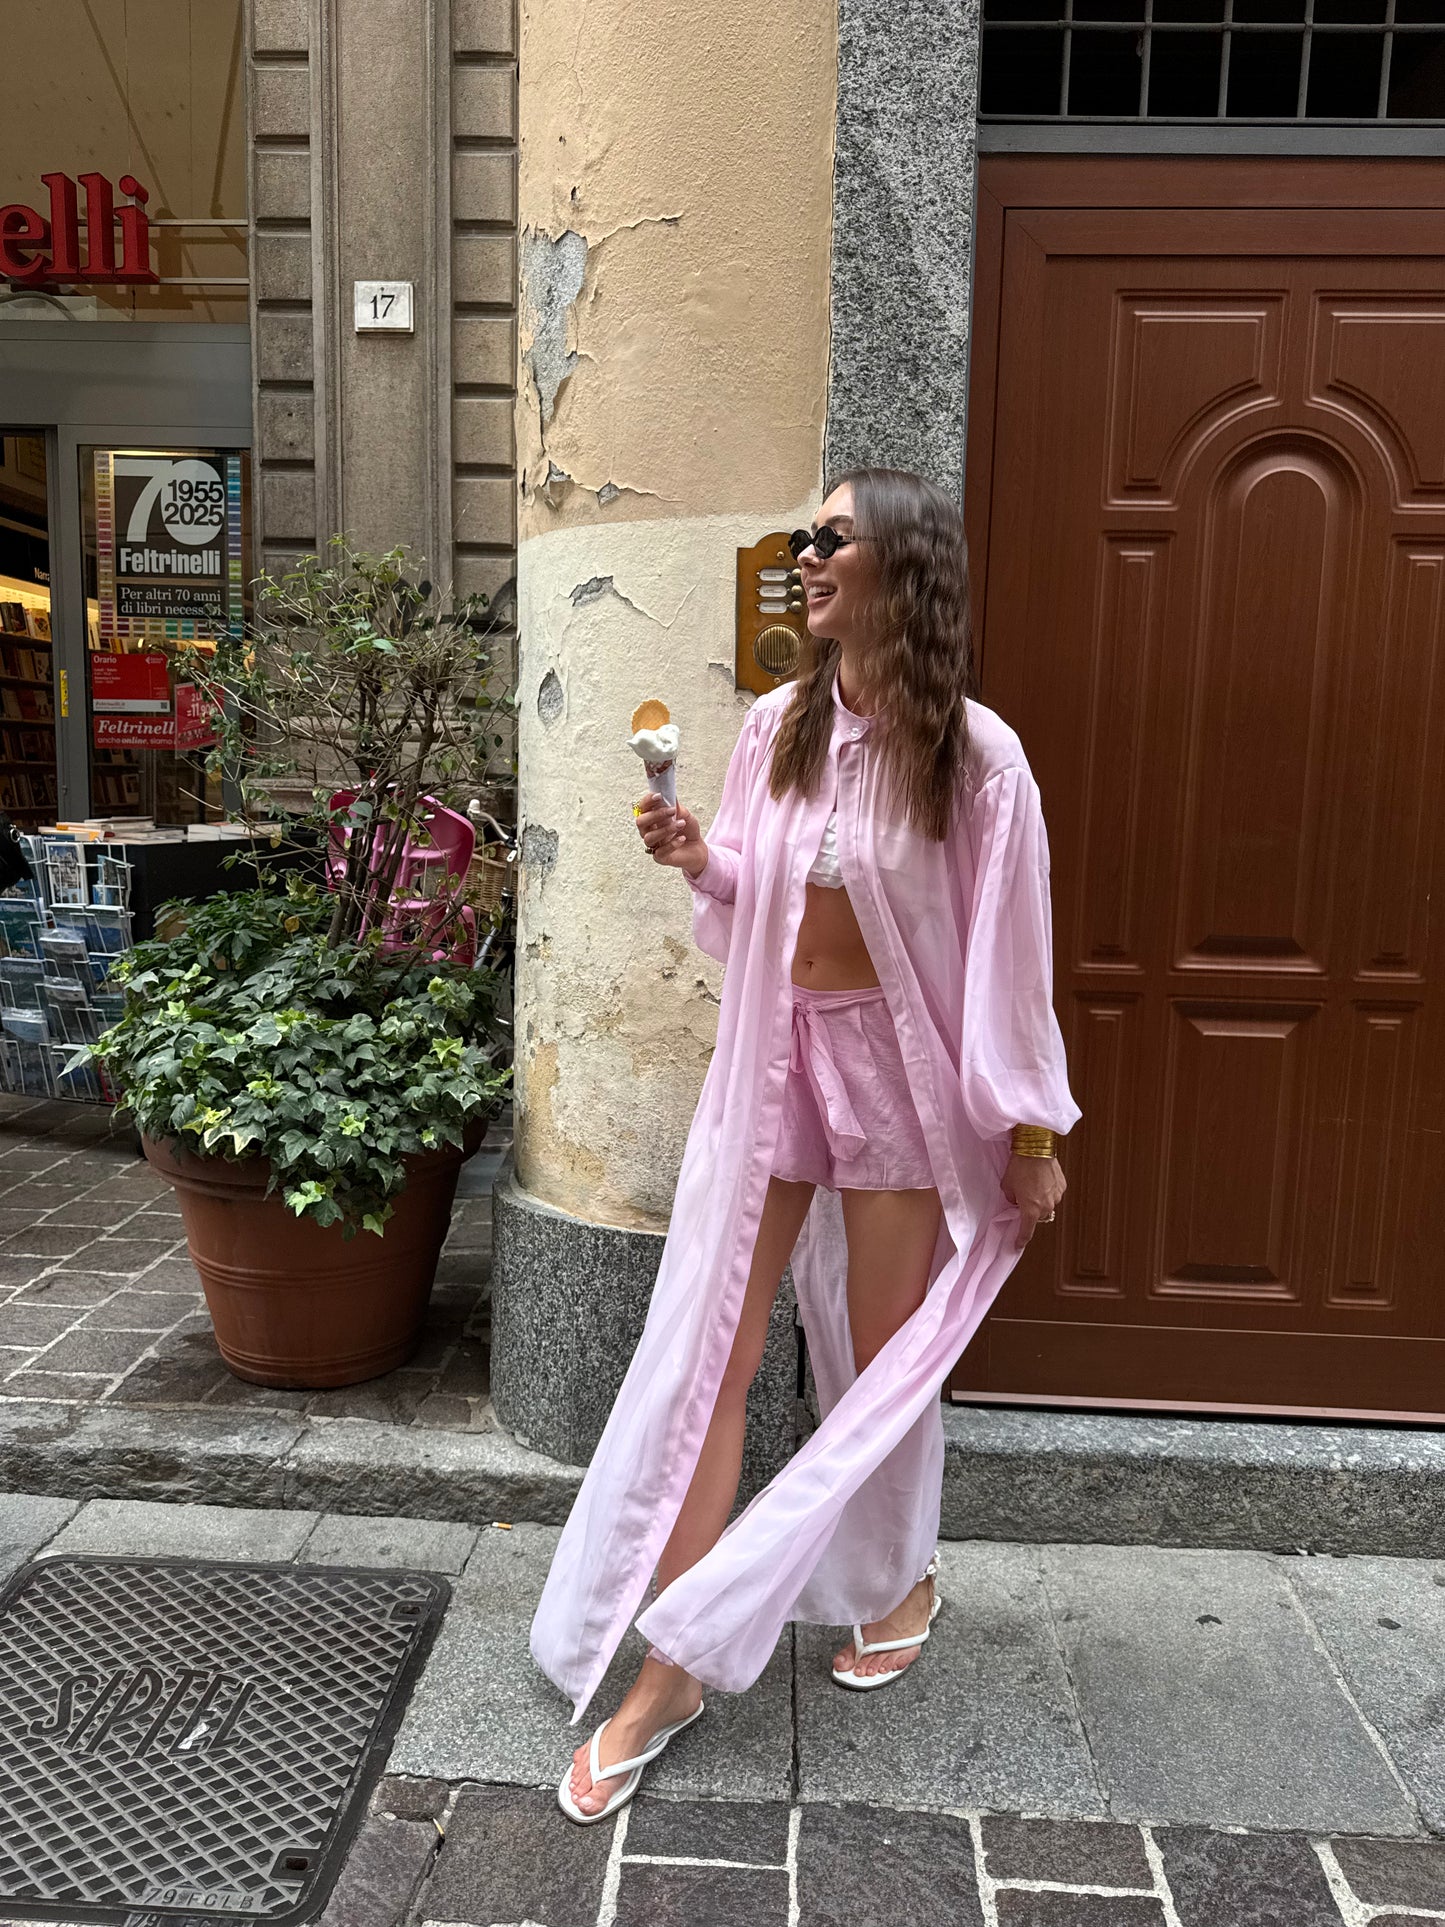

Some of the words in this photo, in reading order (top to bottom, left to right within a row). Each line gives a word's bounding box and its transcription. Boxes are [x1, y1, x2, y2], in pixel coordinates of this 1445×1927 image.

[0, 172, 160, 284] elli
[369, 294, 396, 320] 17
[114, 459, 225, 545] 70
[168, 479, 224, 503] 1955
[164, 502, 225, 526] 2025
[120, 548, 221, 575] Feltrinelli
[121, 587, 143, 601] Per
[145, 588, 172, 601] altri
[175, 589, 190, 601] 70
[193, 590, 221, 602] anni
[121, 601, 133, 614] di
[136, 601, 161, 614] libri
[165, 603, 221, 616] necessri
[93, 655, 117, 664] Orario
[97, 719, 175, 735] Feltrinell
[97, 736, 121, 744] anche
[150, 737, 173, 745] siamo
[28, 1667, 256, 1758] SIPTEL
